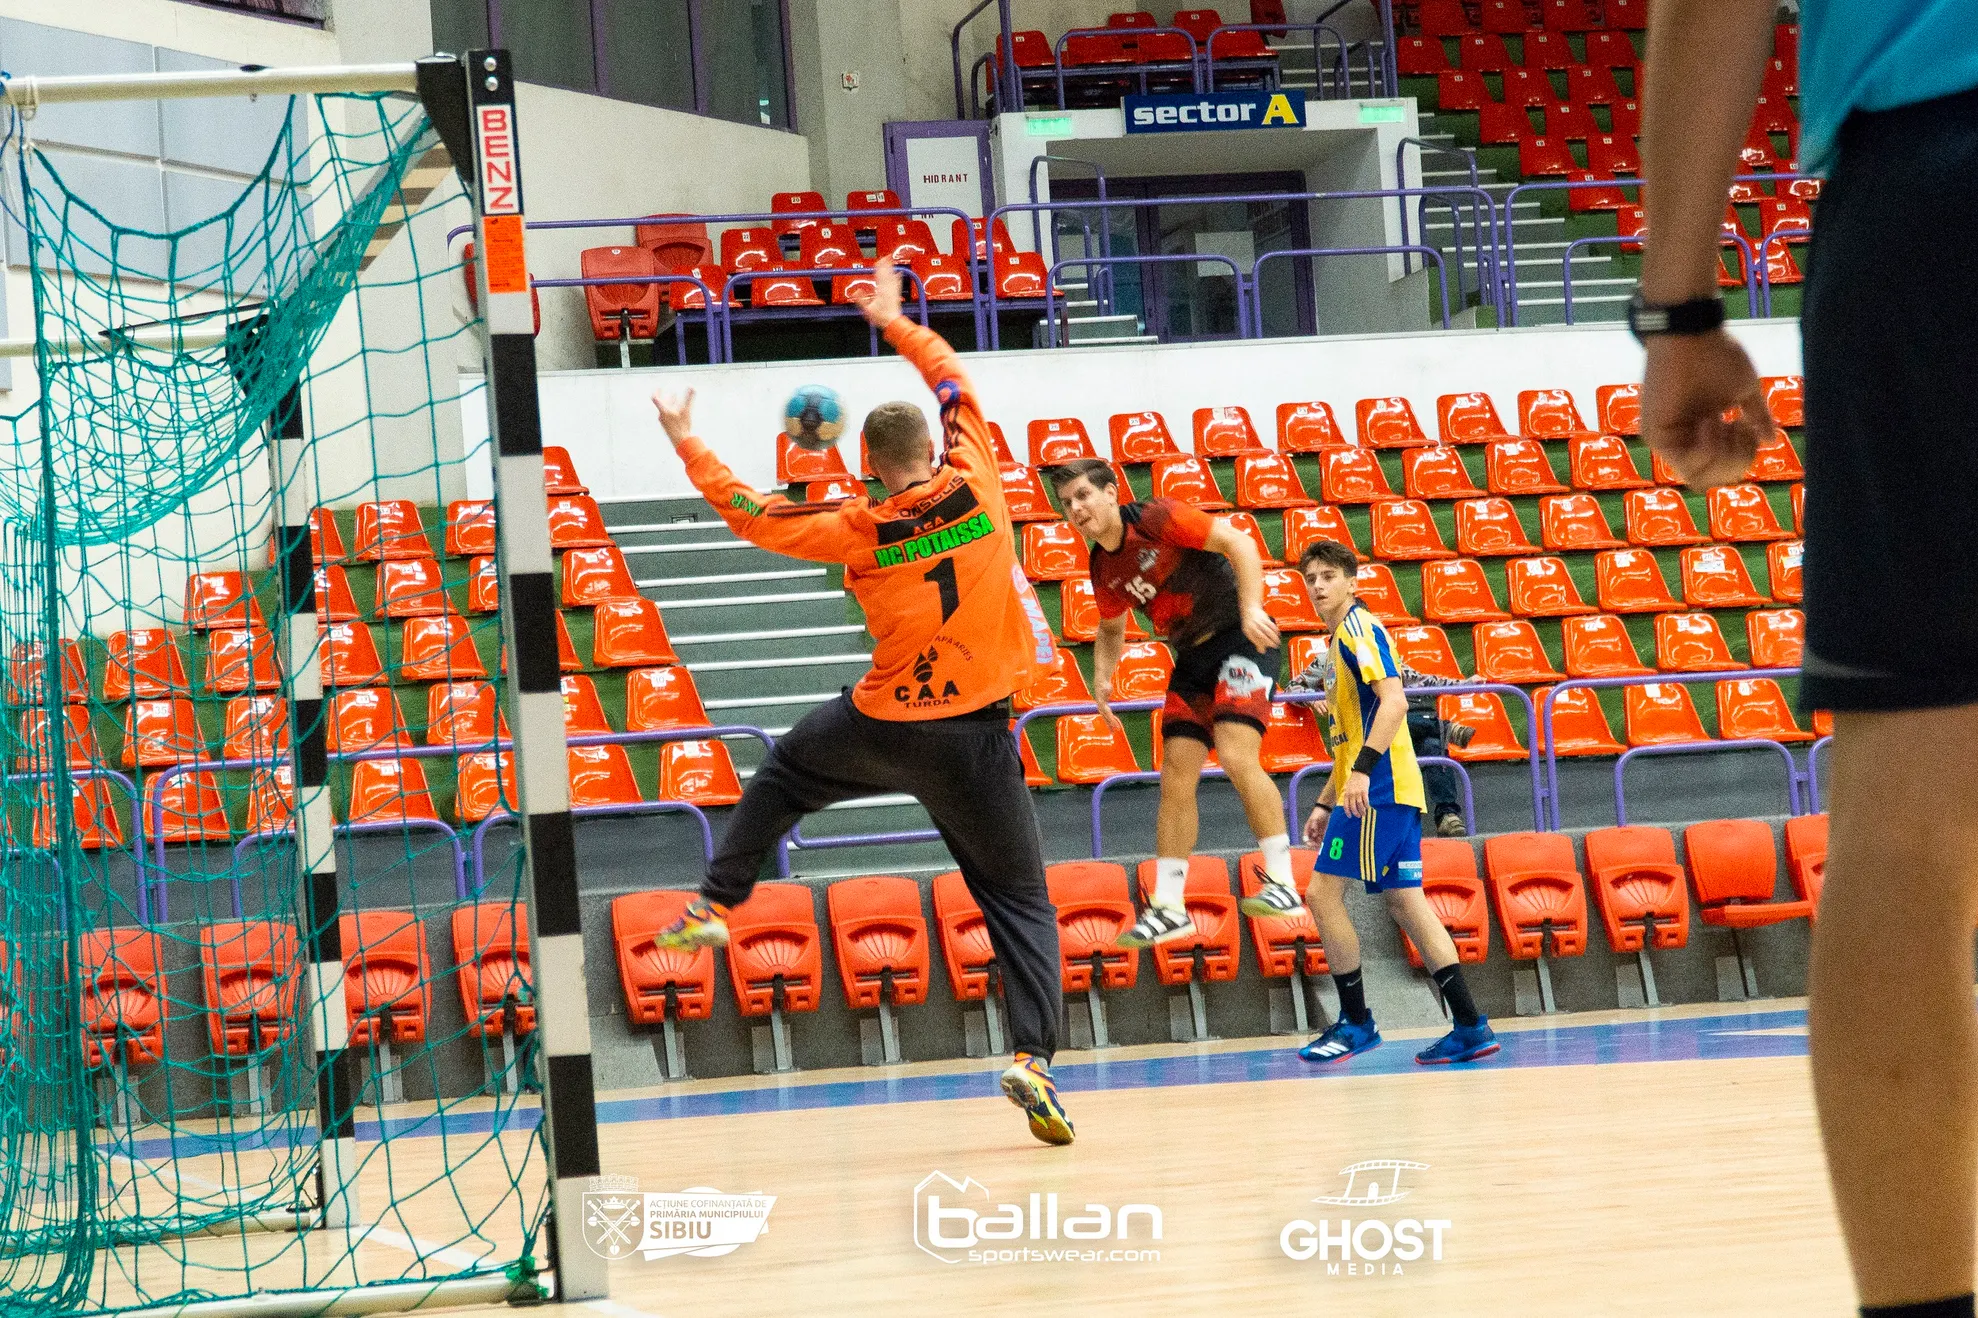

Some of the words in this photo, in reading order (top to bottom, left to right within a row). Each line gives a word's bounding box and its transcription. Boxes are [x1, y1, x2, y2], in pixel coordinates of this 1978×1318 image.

[1133, 102, 1256, 125] sector
[1261, 94, 1299, 125] A
[482, 109, 513, 210] BENZ
[923, 173, 968, 183] HIDRANT
[875, 545, 903, 569] HC
[904, 512, 995, 562] POTAISSA
[924, 557, 960, 626] 1
[1124, 576, 1157, 605] 15
[155, 705, 168, 715] 35
[904, 699, 951, 709] TURDA
[1329, 837, 1344, 861] 8
